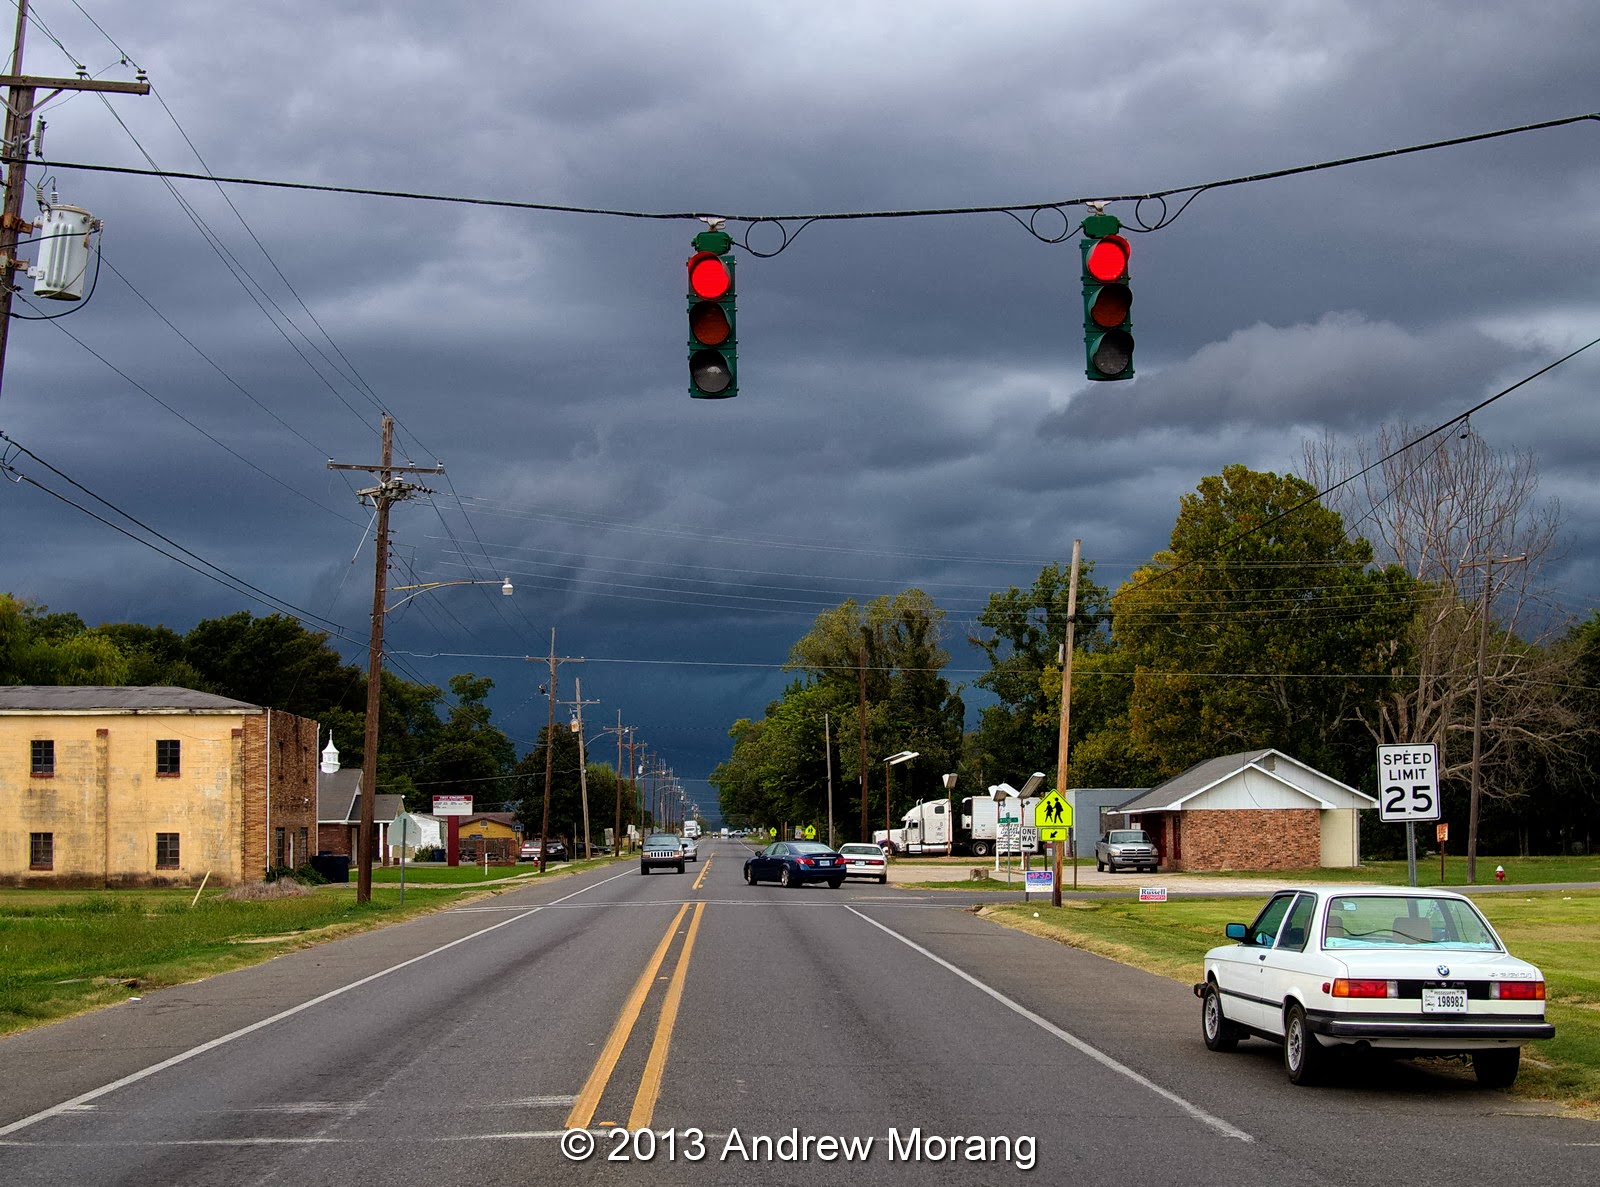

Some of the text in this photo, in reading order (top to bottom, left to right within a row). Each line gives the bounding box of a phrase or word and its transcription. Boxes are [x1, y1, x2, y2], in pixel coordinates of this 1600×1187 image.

[1383, 752, 1432, 765] SPEED
[1389, 768, 1427, 781] LIMIT
[1385, 785, 1432, 812] 25
[1437, 995, 1464, 1008] 198982
